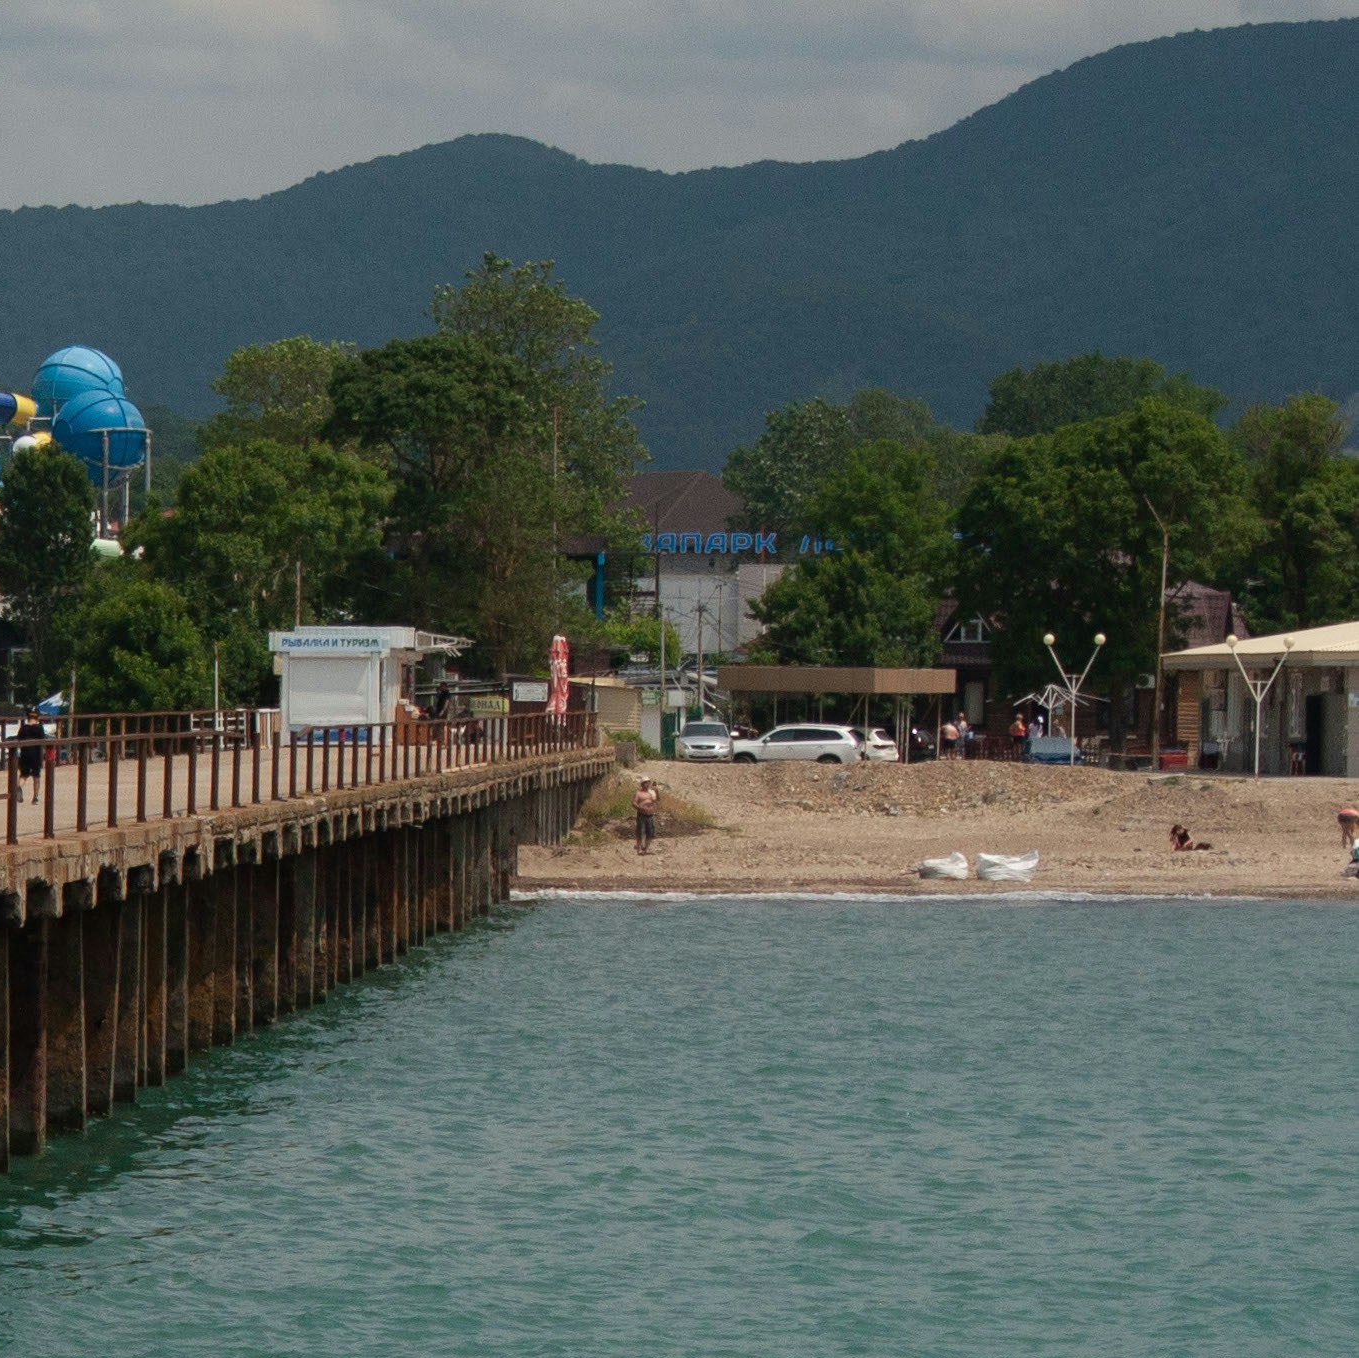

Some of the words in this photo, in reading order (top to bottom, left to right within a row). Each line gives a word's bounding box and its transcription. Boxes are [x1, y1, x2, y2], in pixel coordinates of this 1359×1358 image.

[281, 638, 330, 648] РЫБАЛКА
[332, 638, 338, 648] И
[340, 638, 380, 648] ТУРИЗМ
